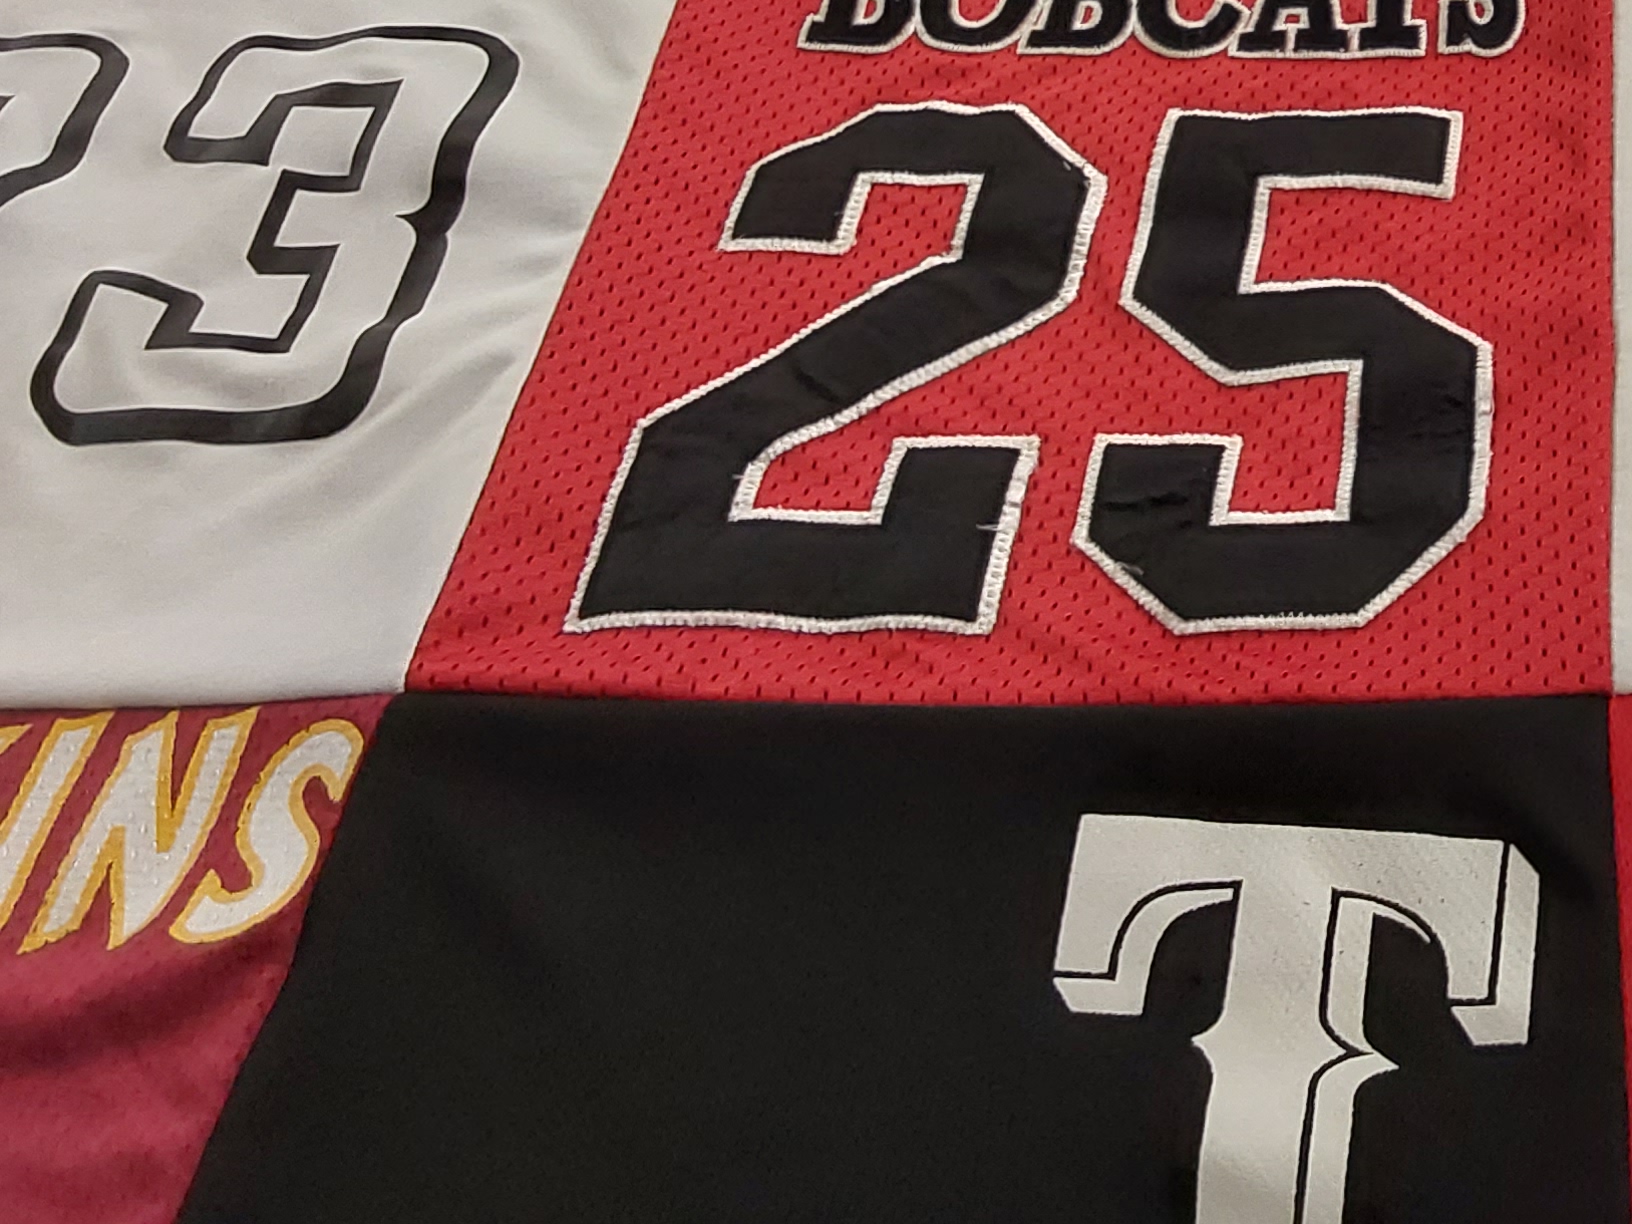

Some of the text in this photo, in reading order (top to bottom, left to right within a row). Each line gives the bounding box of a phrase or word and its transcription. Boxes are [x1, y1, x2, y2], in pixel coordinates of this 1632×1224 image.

[562, 100, 1494, 636] 25
[0, 704, 365, 956] INS
[1053, 812, 1541, 1224] T
